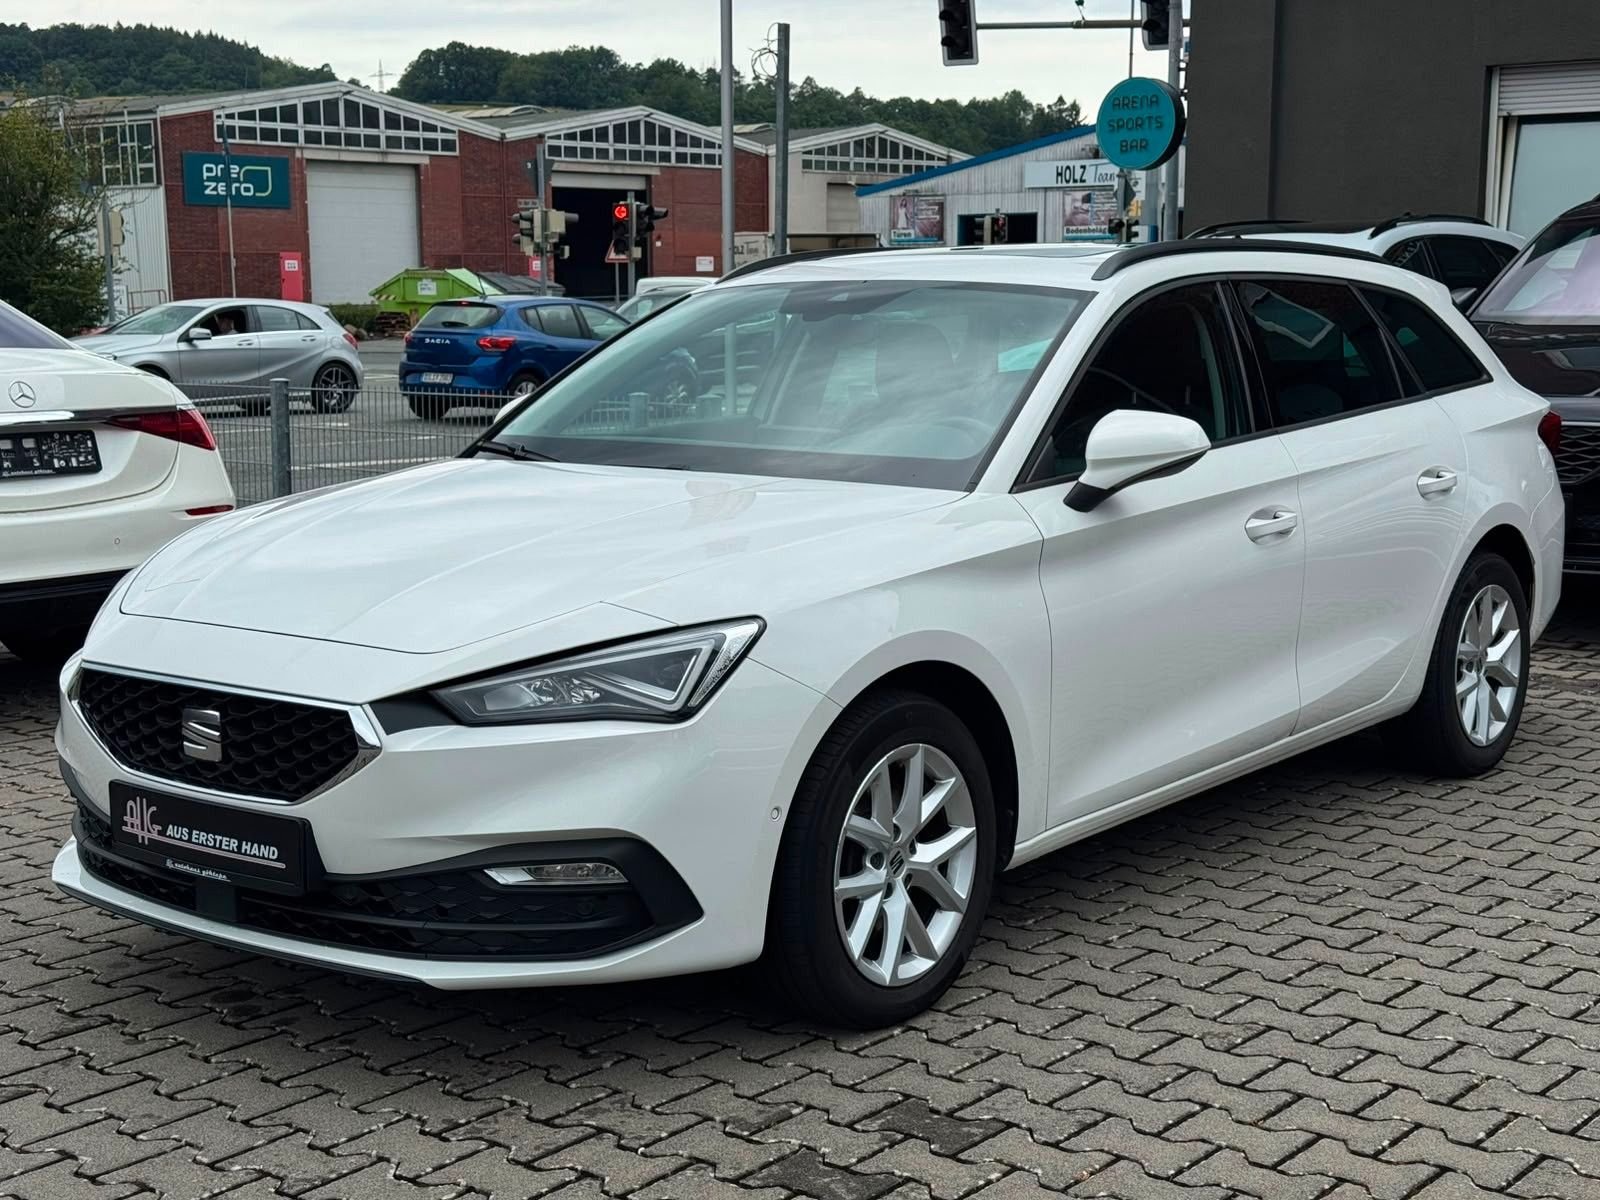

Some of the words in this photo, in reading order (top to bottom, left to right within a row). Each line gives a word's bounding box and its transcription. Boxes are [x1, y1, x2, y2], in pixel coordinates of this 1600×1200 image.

[1112, 94, 1159, 112] ARENA
[1107, 115, 1164, 133] SPORTS
[1119, 138, 1149, 154] BAR
[202, 163, 240, 181] pre
[1055, 164, 1087, 185] HOLZ
[203, 181, 254, 197] zero
[166, 823, 189, 841] AUS
[191, 829, 238, 852] ERSTER
[241, 840, 279, 860] HAND
